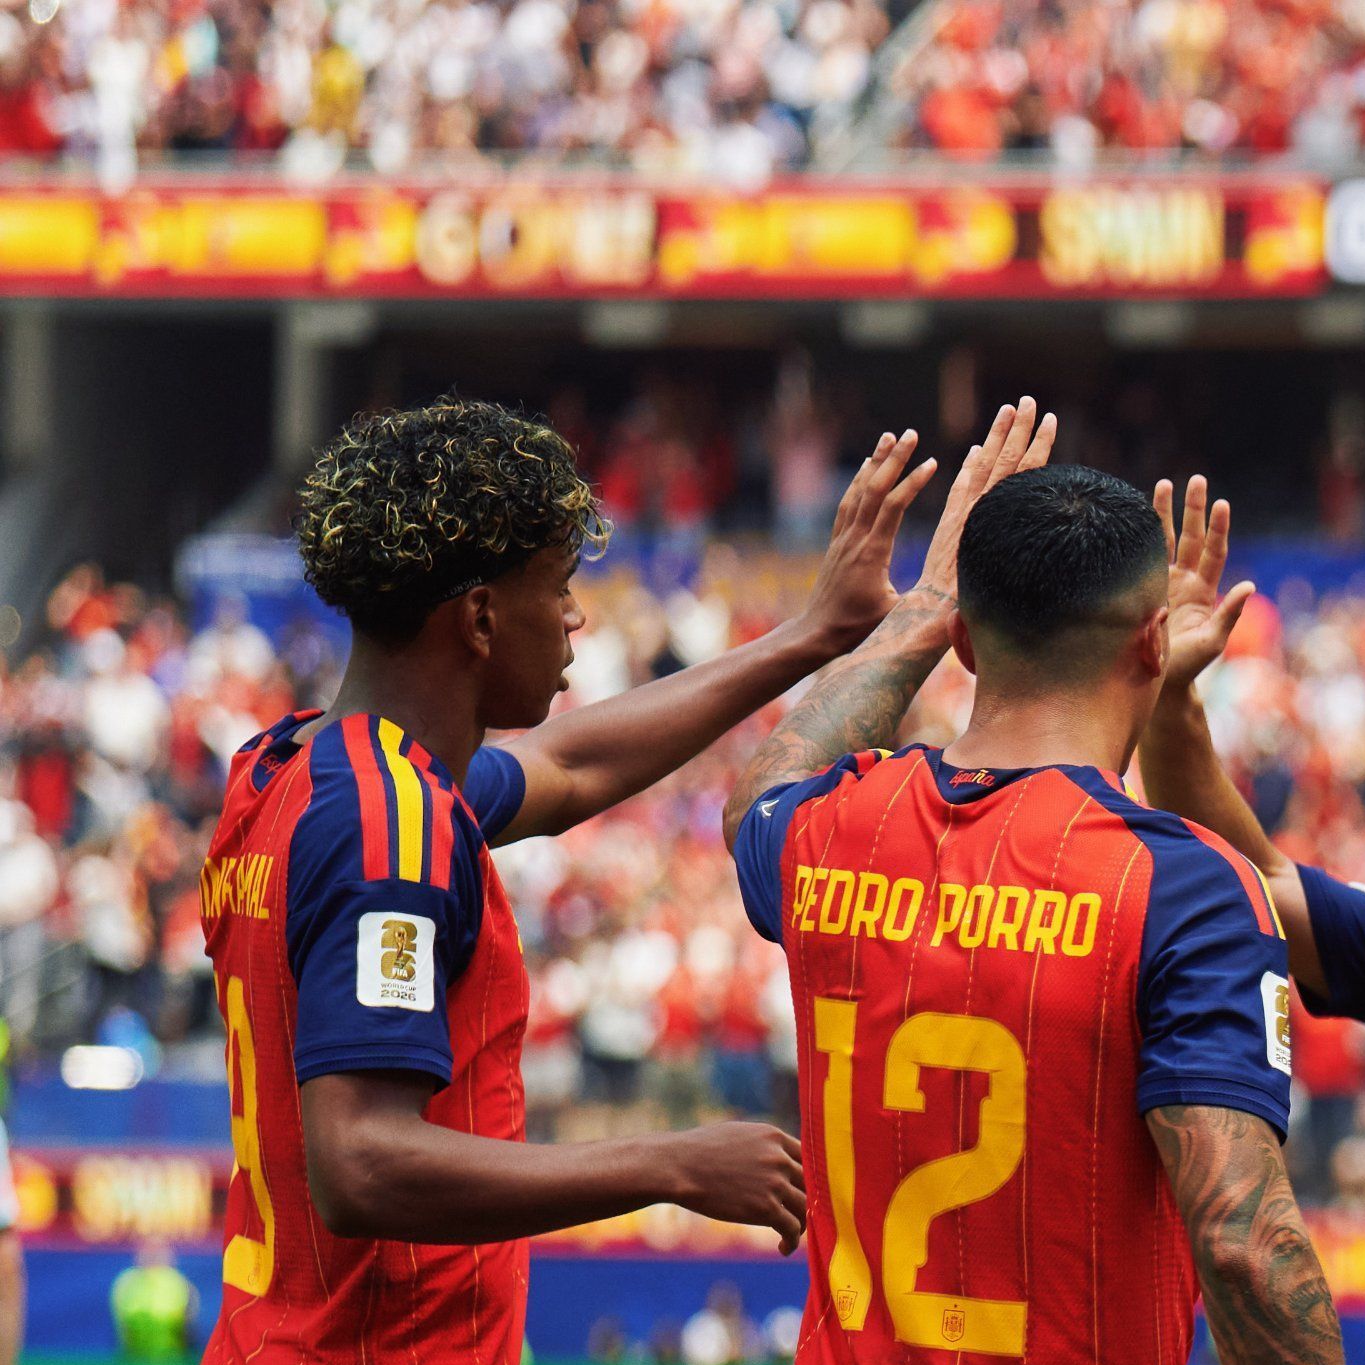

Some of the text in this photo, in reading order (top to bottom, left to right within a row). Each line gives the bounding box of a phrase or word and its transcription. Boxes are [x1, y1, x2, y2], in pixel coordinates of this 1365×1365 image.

[380, 989, 417, 1002] 2026
[791, 864, 1102, 958] PEDRO PORRO
[212, 970, 275, 1298] 9
[814, 996, 1028, 1358] 12
